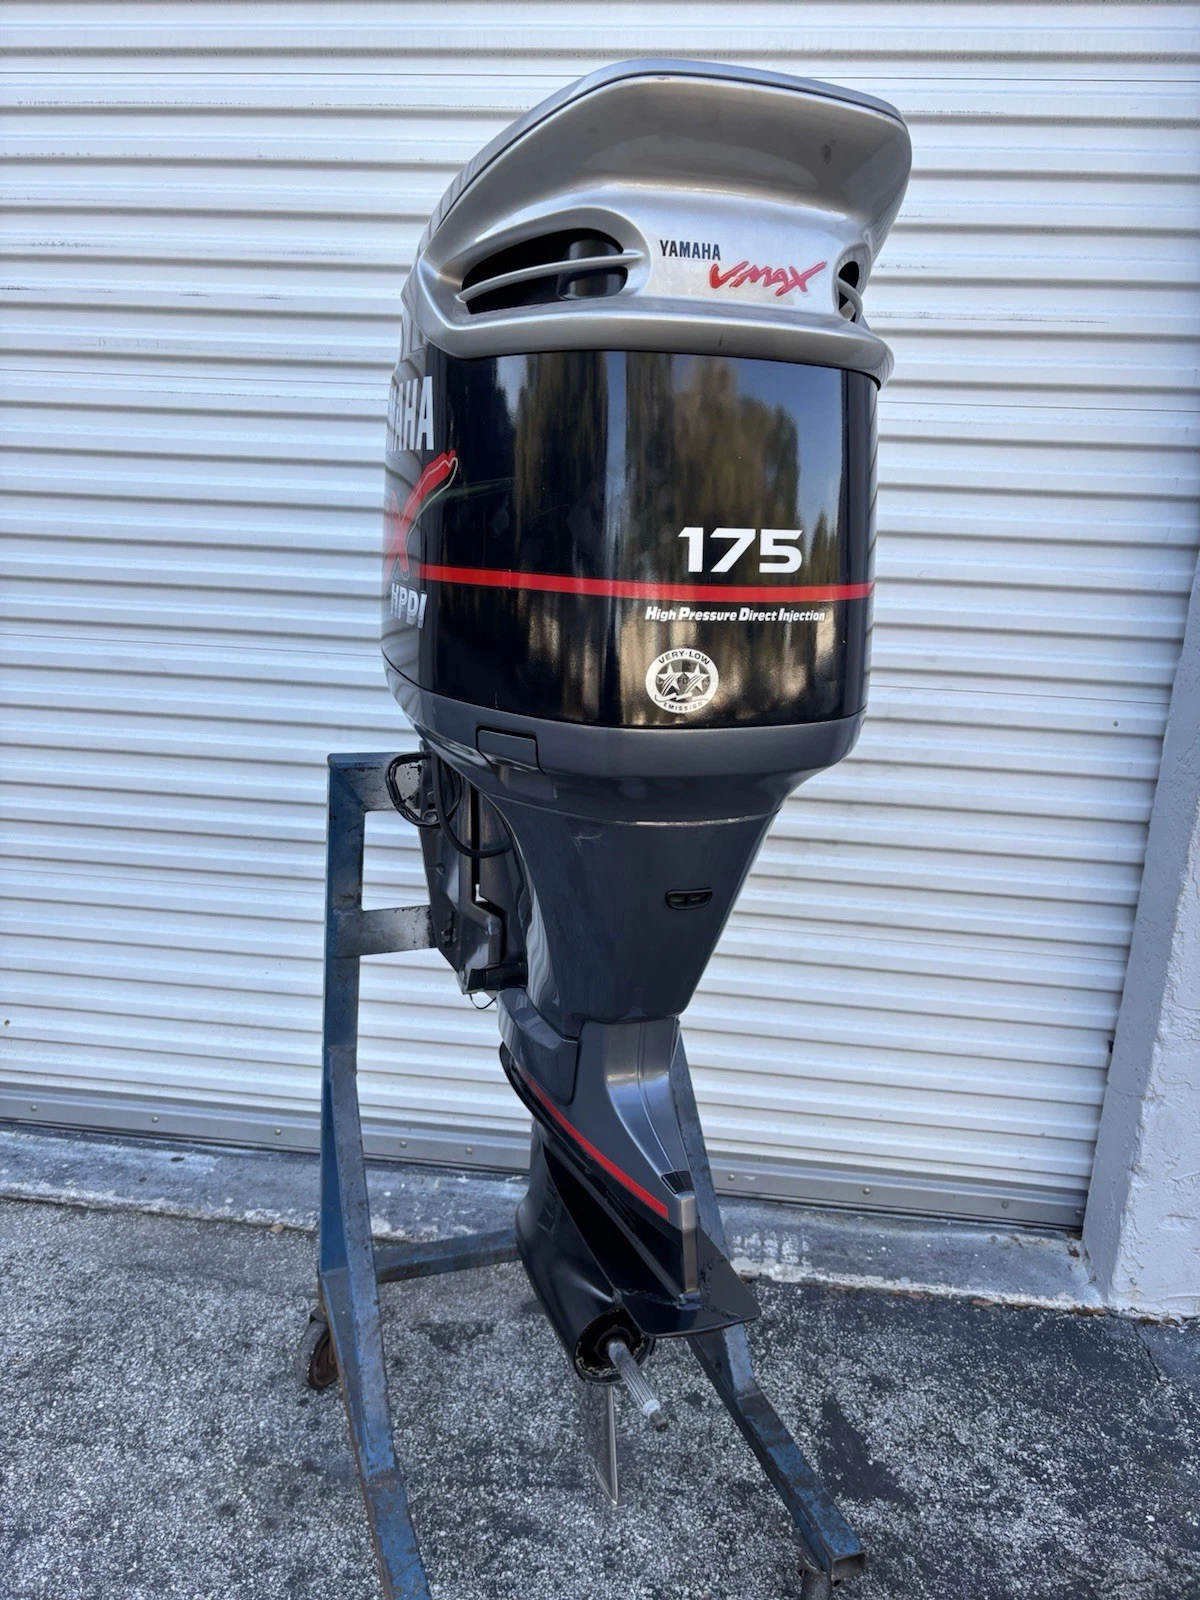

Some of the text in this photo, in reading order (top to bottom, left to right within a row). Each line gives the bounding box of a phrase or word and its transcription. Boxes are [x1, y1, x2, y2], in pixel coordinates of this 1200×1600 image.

[659, 239, 721, 261] YAMAHA
[677, 526, 803, 573] 175
[390, 582, 428, 629] HPDI
[645, 606, 826, 622] High Pressure Direct Injection
